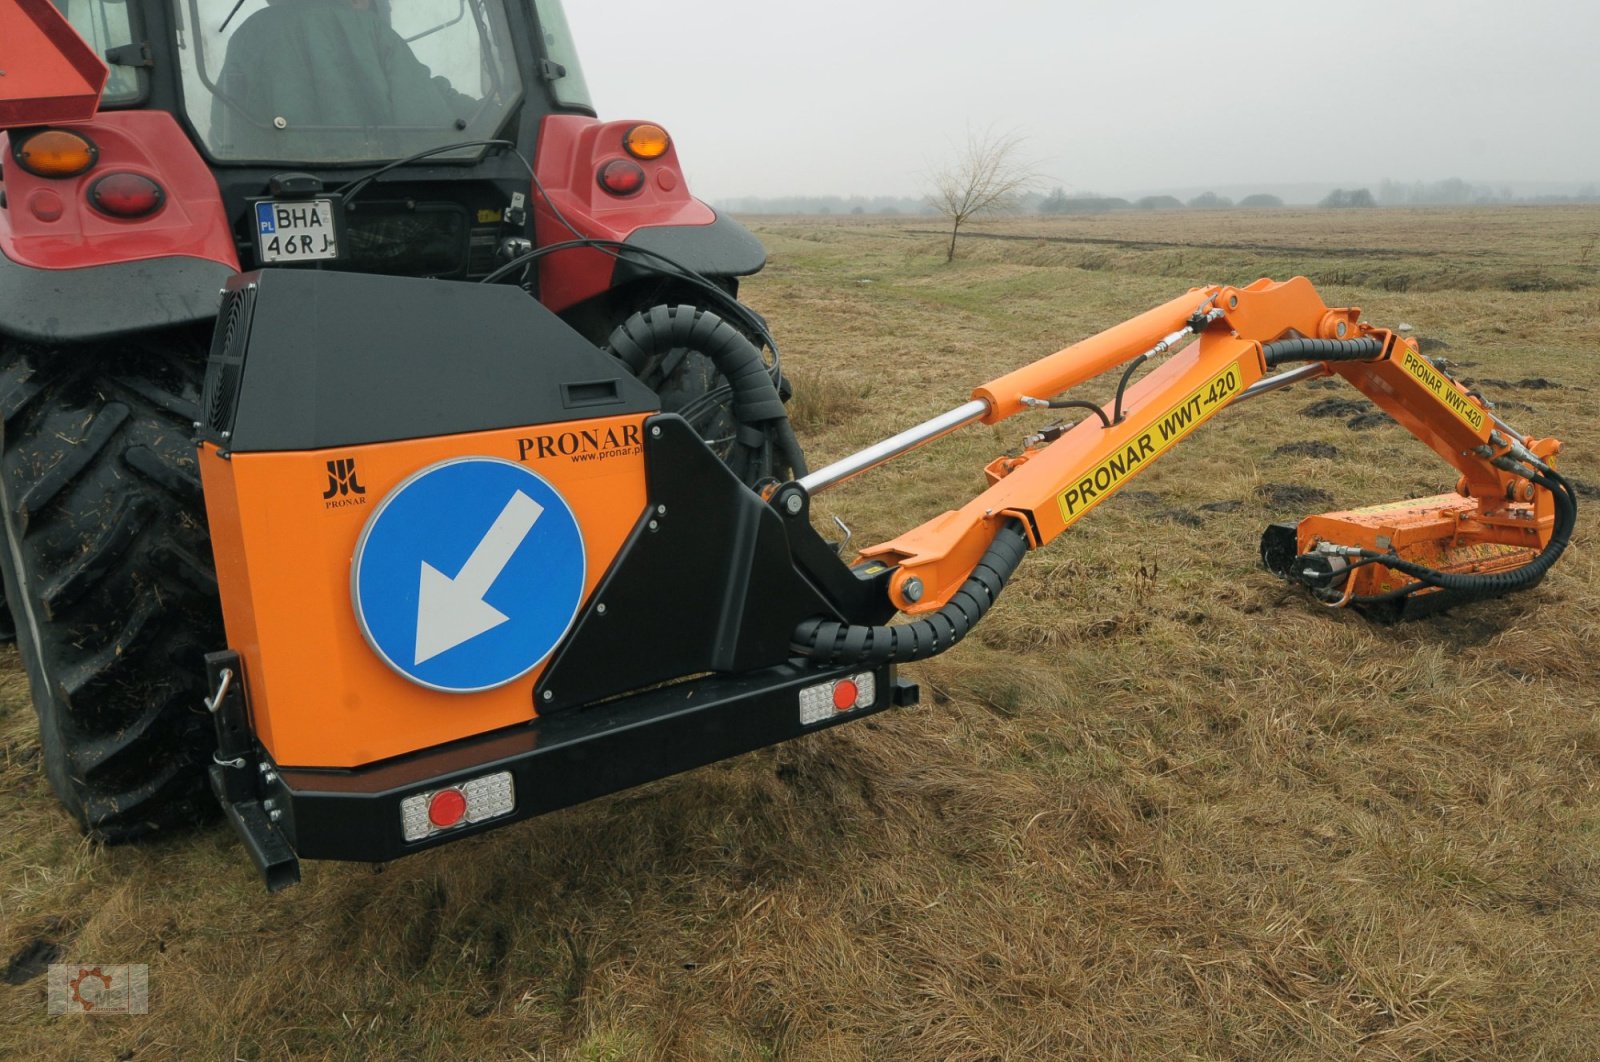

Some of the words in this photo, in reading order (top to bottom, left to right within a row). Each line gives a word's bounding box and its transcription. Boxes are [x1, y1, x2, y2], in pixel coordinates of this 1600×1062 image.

[261, 221, 274, 231] PL
[276, 207, 322, 229] BHA
[267, 233, 328, 256] 46RJ
[1404, 353, 1443, 395] PRONAR
[1445, 387, 1482, 428] WWT-420
[517, 424, 645, 462] PRONAR
[571, 445, 644, 463] www.pronar.pl
[1064, 433, 1156, 516] PRONAR
[1158, 370, 1237, 442] WWT-420
[325, 496, 366, 509] PRONAR
